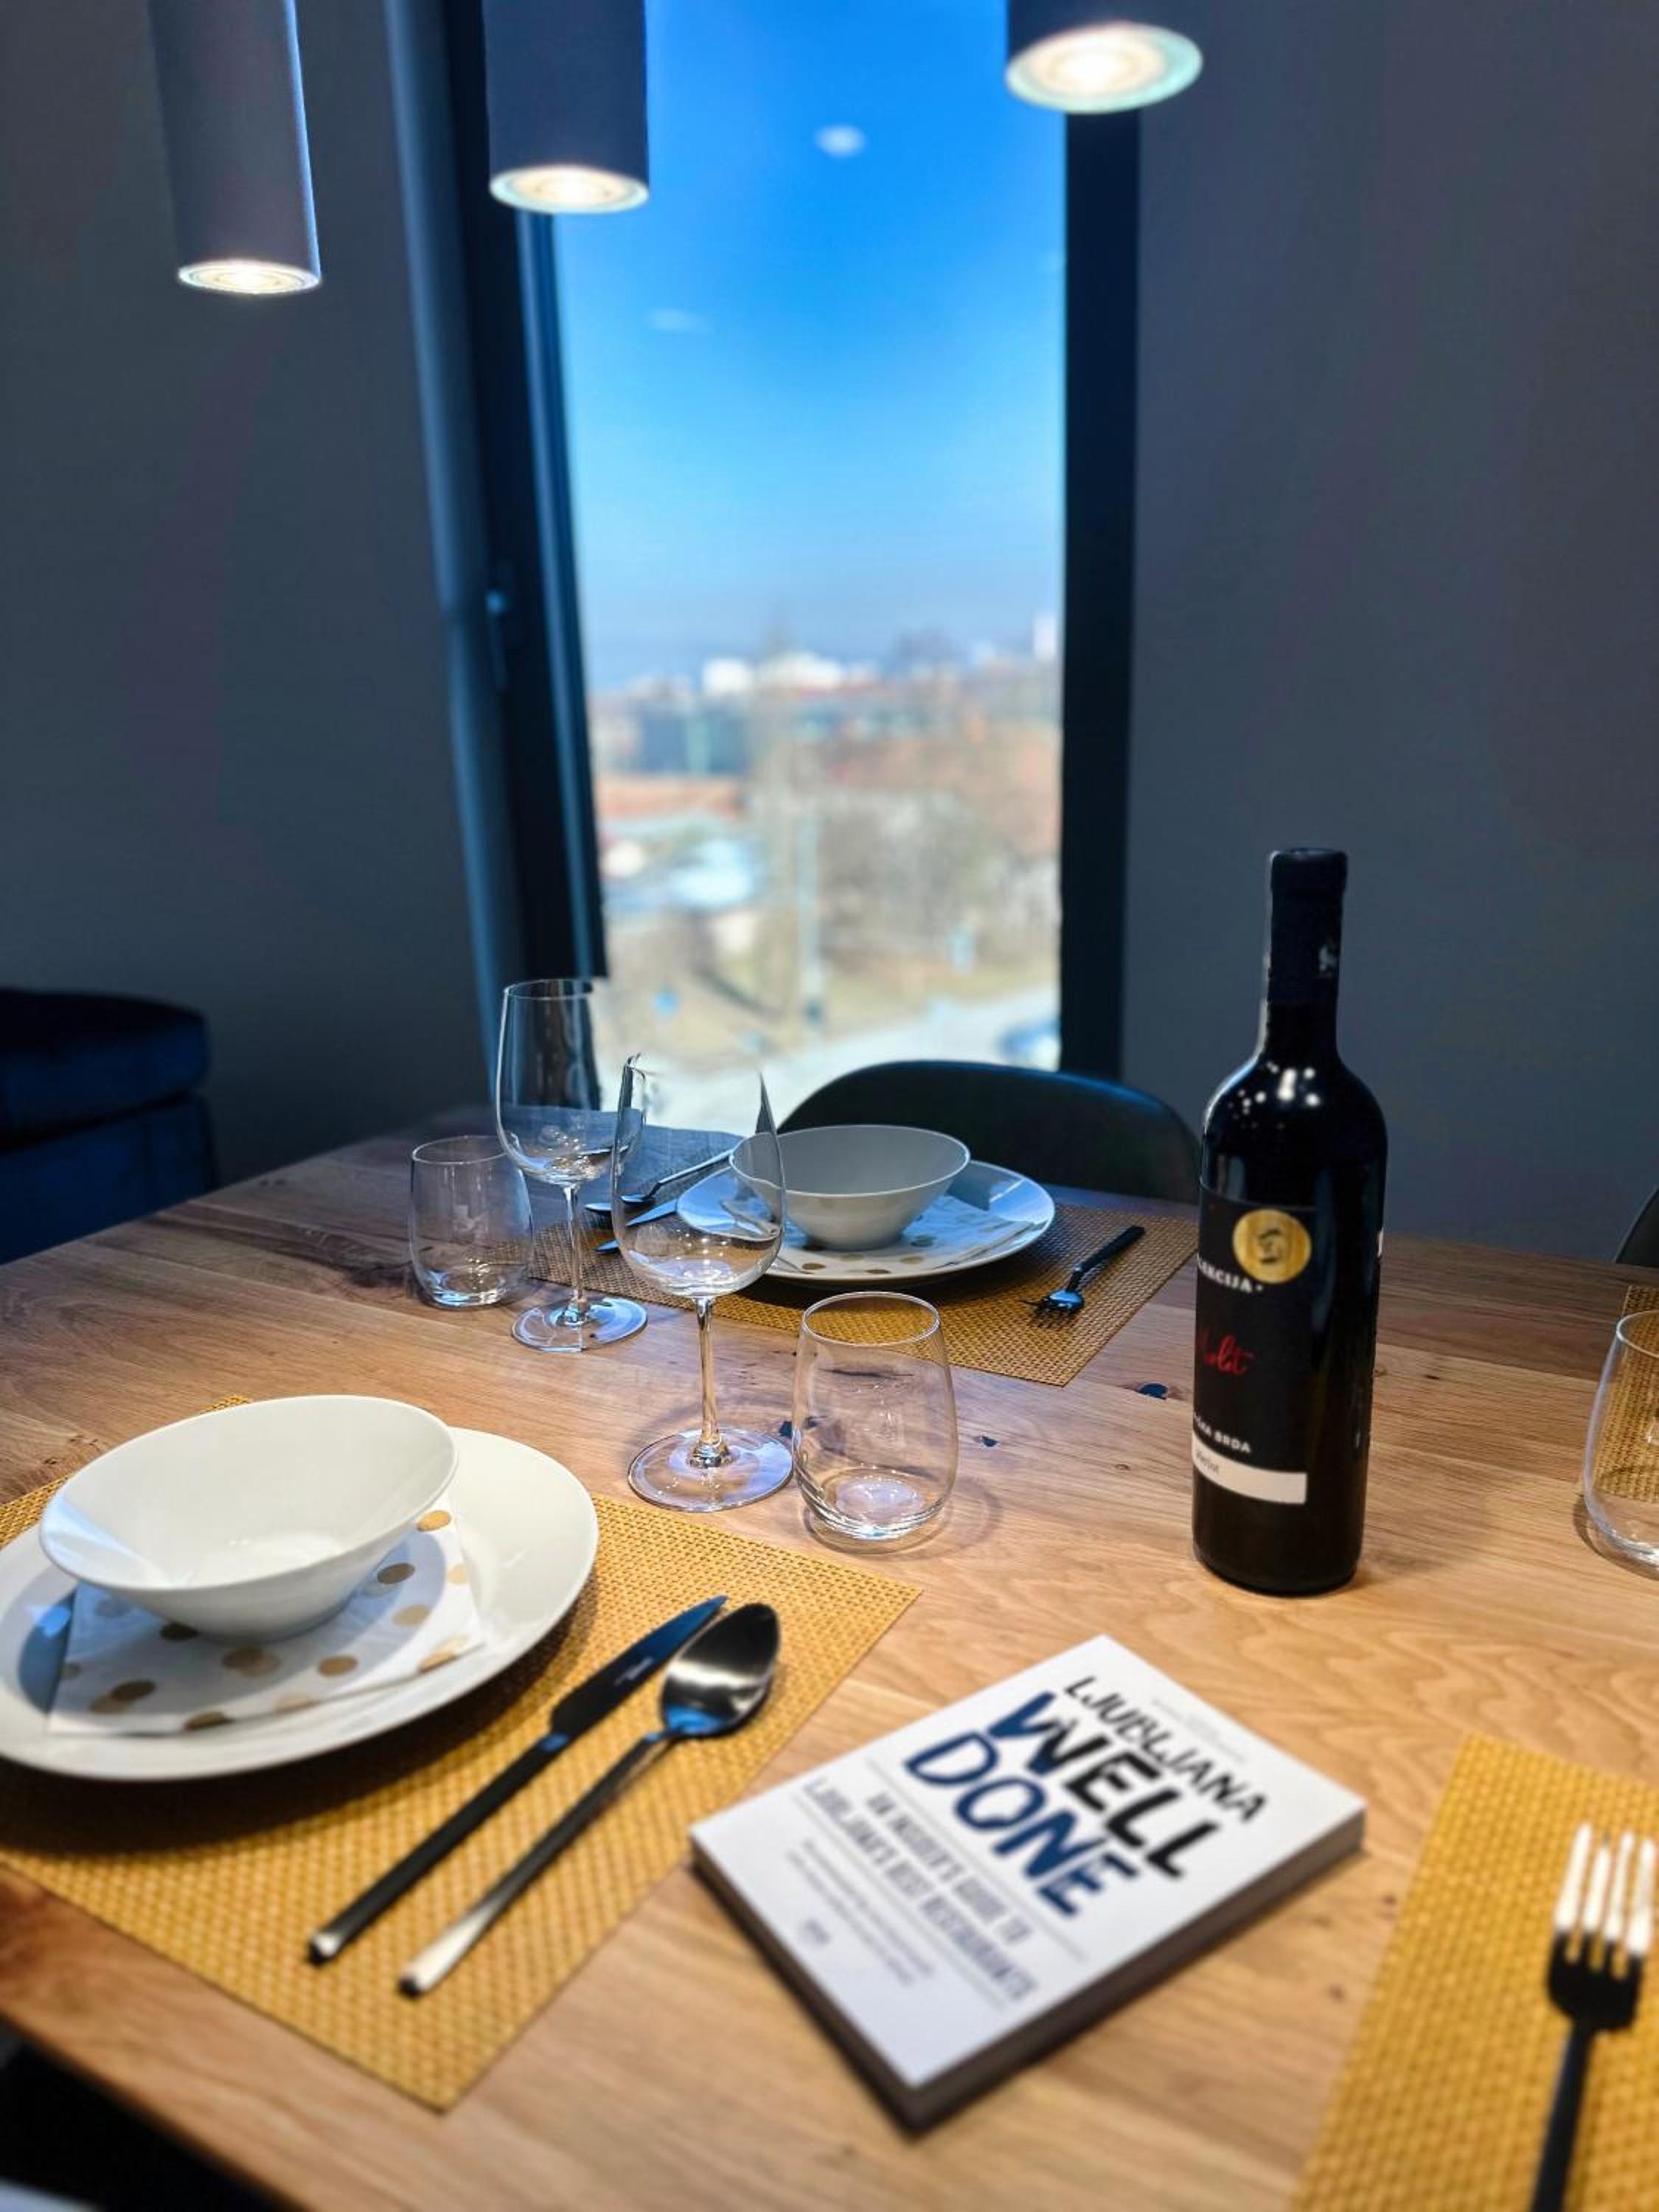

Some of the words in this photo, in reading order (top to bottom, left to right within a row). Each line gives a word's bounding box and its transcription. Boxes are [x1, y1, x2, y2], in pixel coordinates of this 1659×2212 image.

[1214, 1430, 1251, 1453] BRDA
[902, 1731, 1140, 1917] DONE
[985, 1691, 1220, 1879] WELL
[1063, 1675, 1267, 1823] LJUBLJANA
